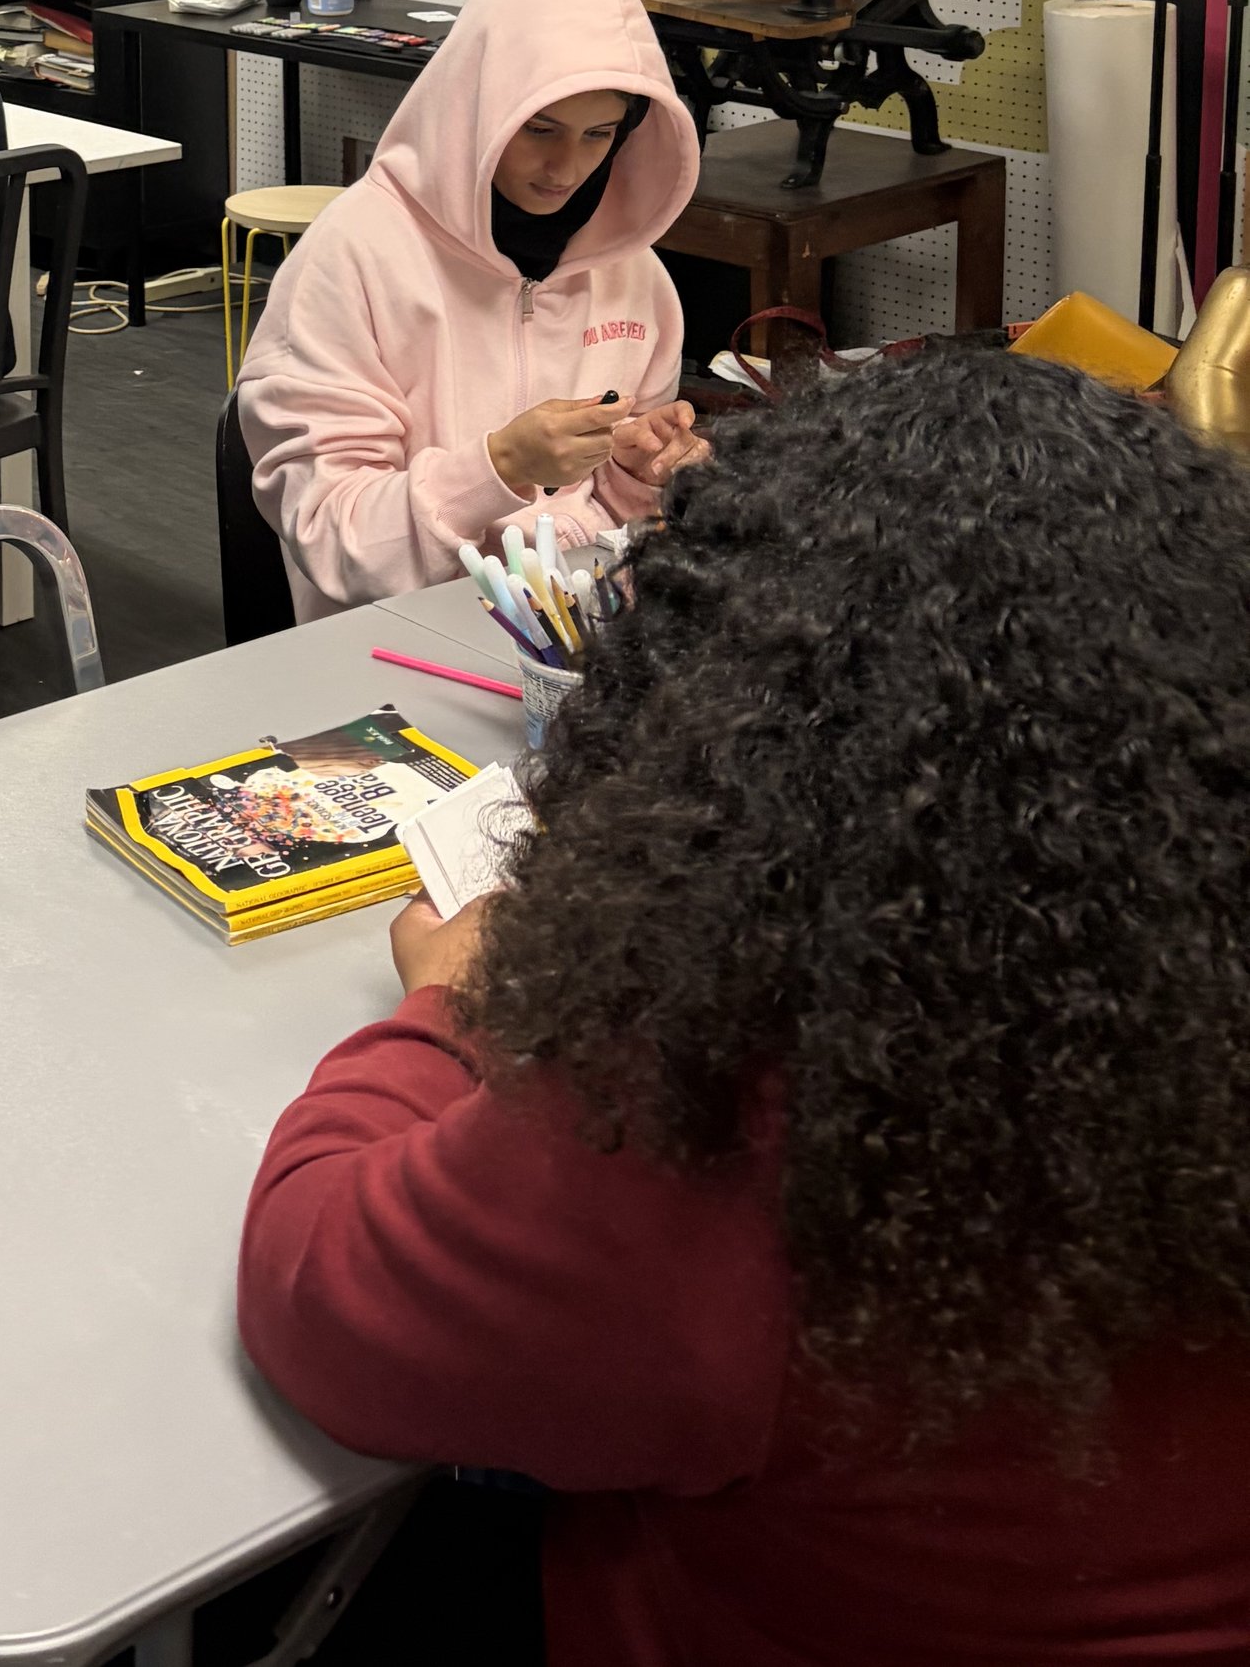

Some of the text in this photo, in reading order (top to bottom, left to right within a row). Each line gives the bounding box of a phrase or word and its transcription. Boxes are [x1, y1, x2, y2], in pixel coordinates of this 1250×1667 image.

[314, 780, 393, 834] Teenage
[354, 773, 397, 801] Bra
[152, 786, 291, 877] GEGRAPHIC
[153, 811, 244, 873] NATIONA
